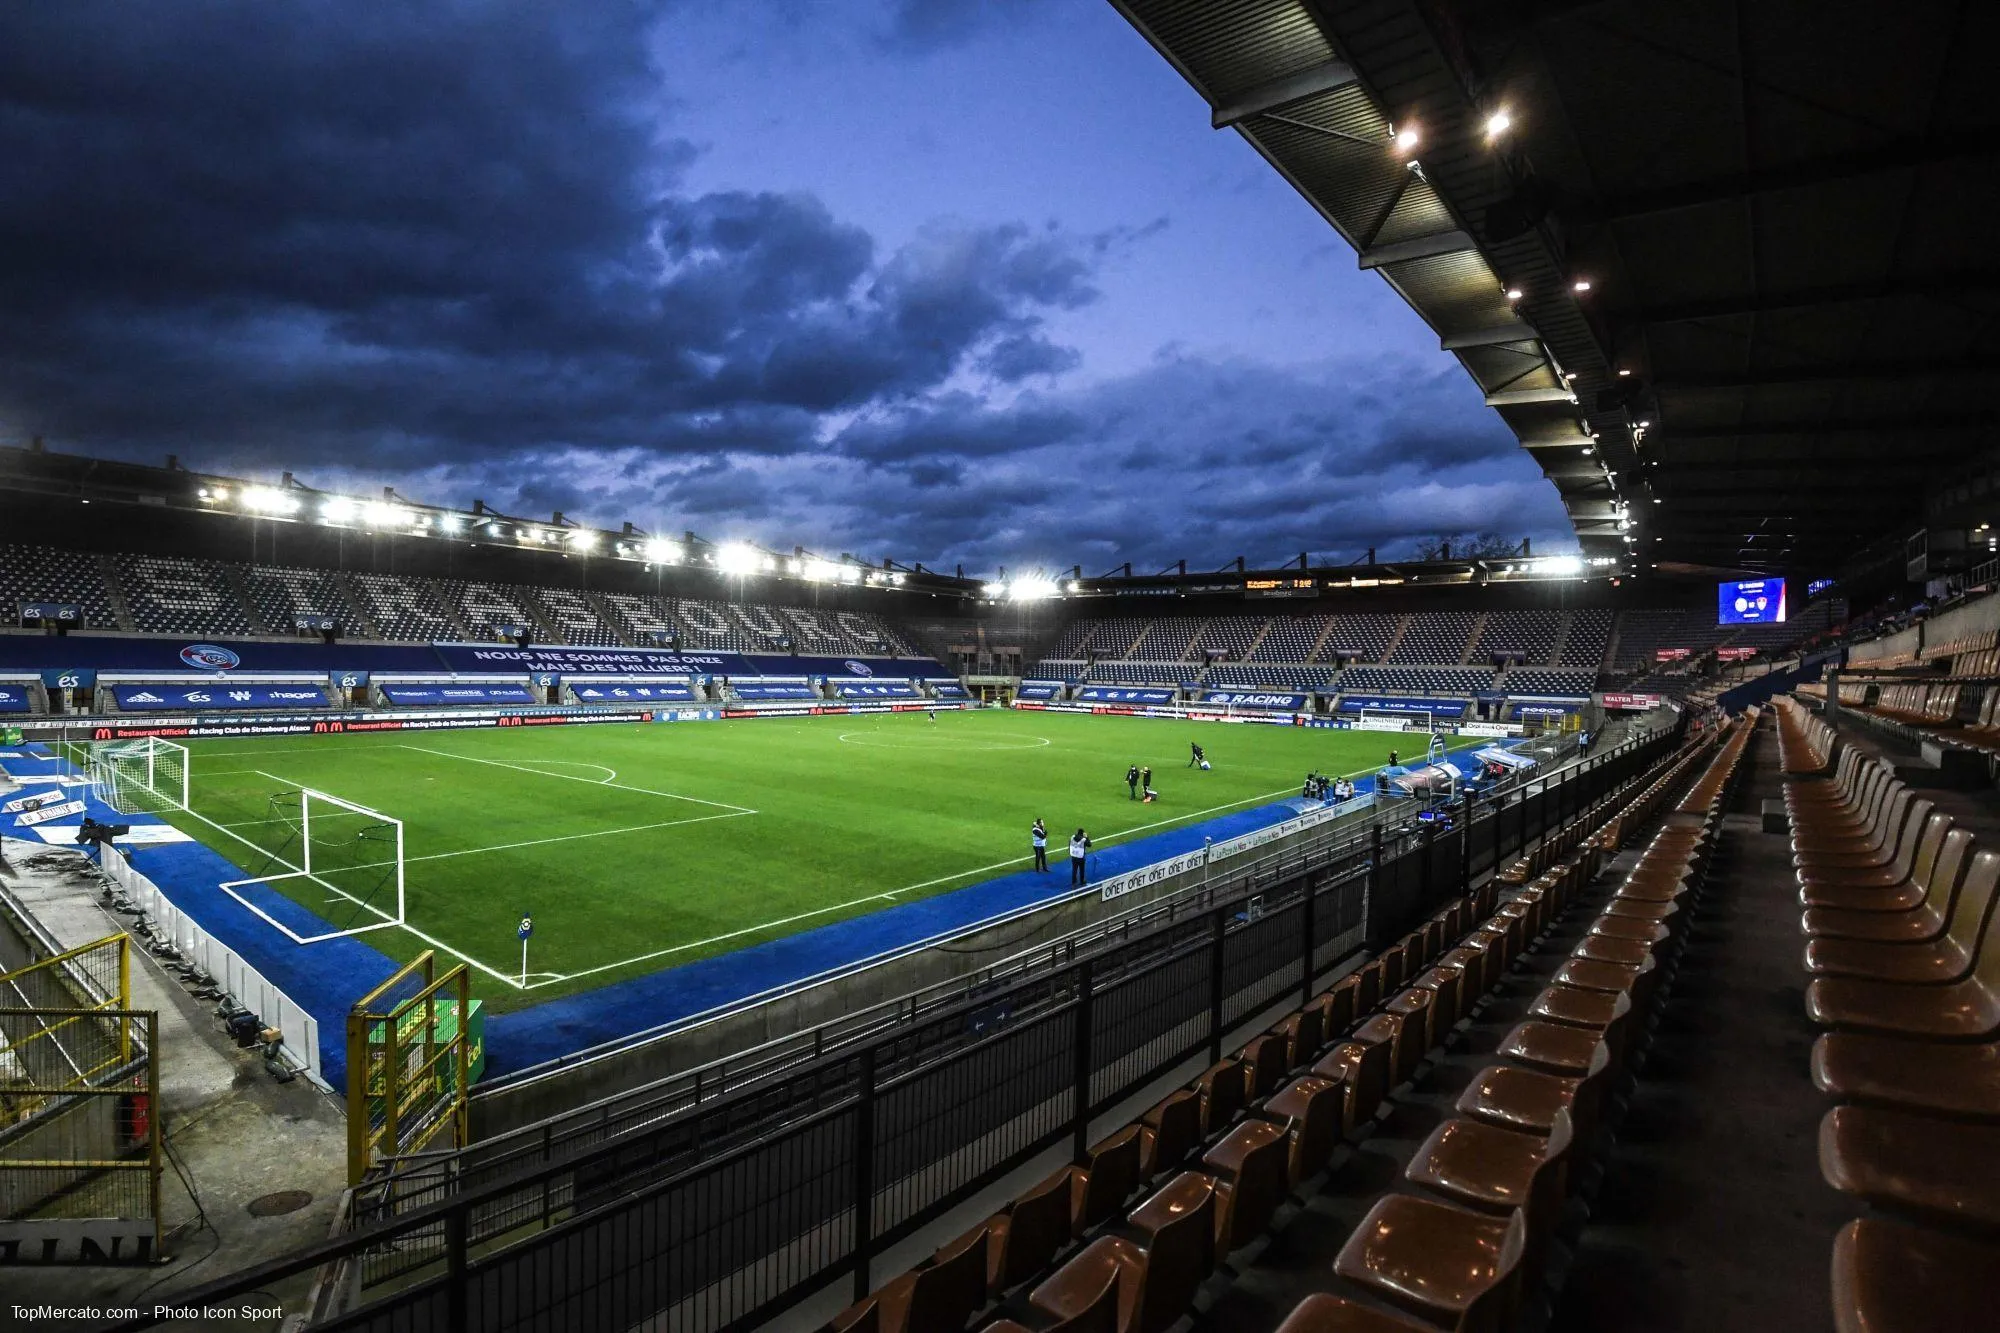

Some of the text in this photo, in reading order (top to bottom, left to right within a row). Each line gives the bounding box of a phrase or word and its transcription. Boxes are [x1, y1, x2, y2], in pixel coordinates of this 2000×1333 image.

[473, 650, 724, 664] NOUS NE SOMMES PAS ONZE
[526, 662, 702, 673] MAIS DES MILLIERS !
[1231, 694, 1293, 704] RACING
[347, 722, 380, 730] Restaurant
[410, 721, 429, 729] Racing
[450, 719, 479, 727] Strasbourg
[118, 728, 159, 738] Restaurant
[161, 727, 187, 736] Officiel
[199, 727, 223, 735] Racing
[224, 726, 240, 734] Club
[251, 725, 288, 733] Strasbourg
[289, 724, 310, 732] Alsace
